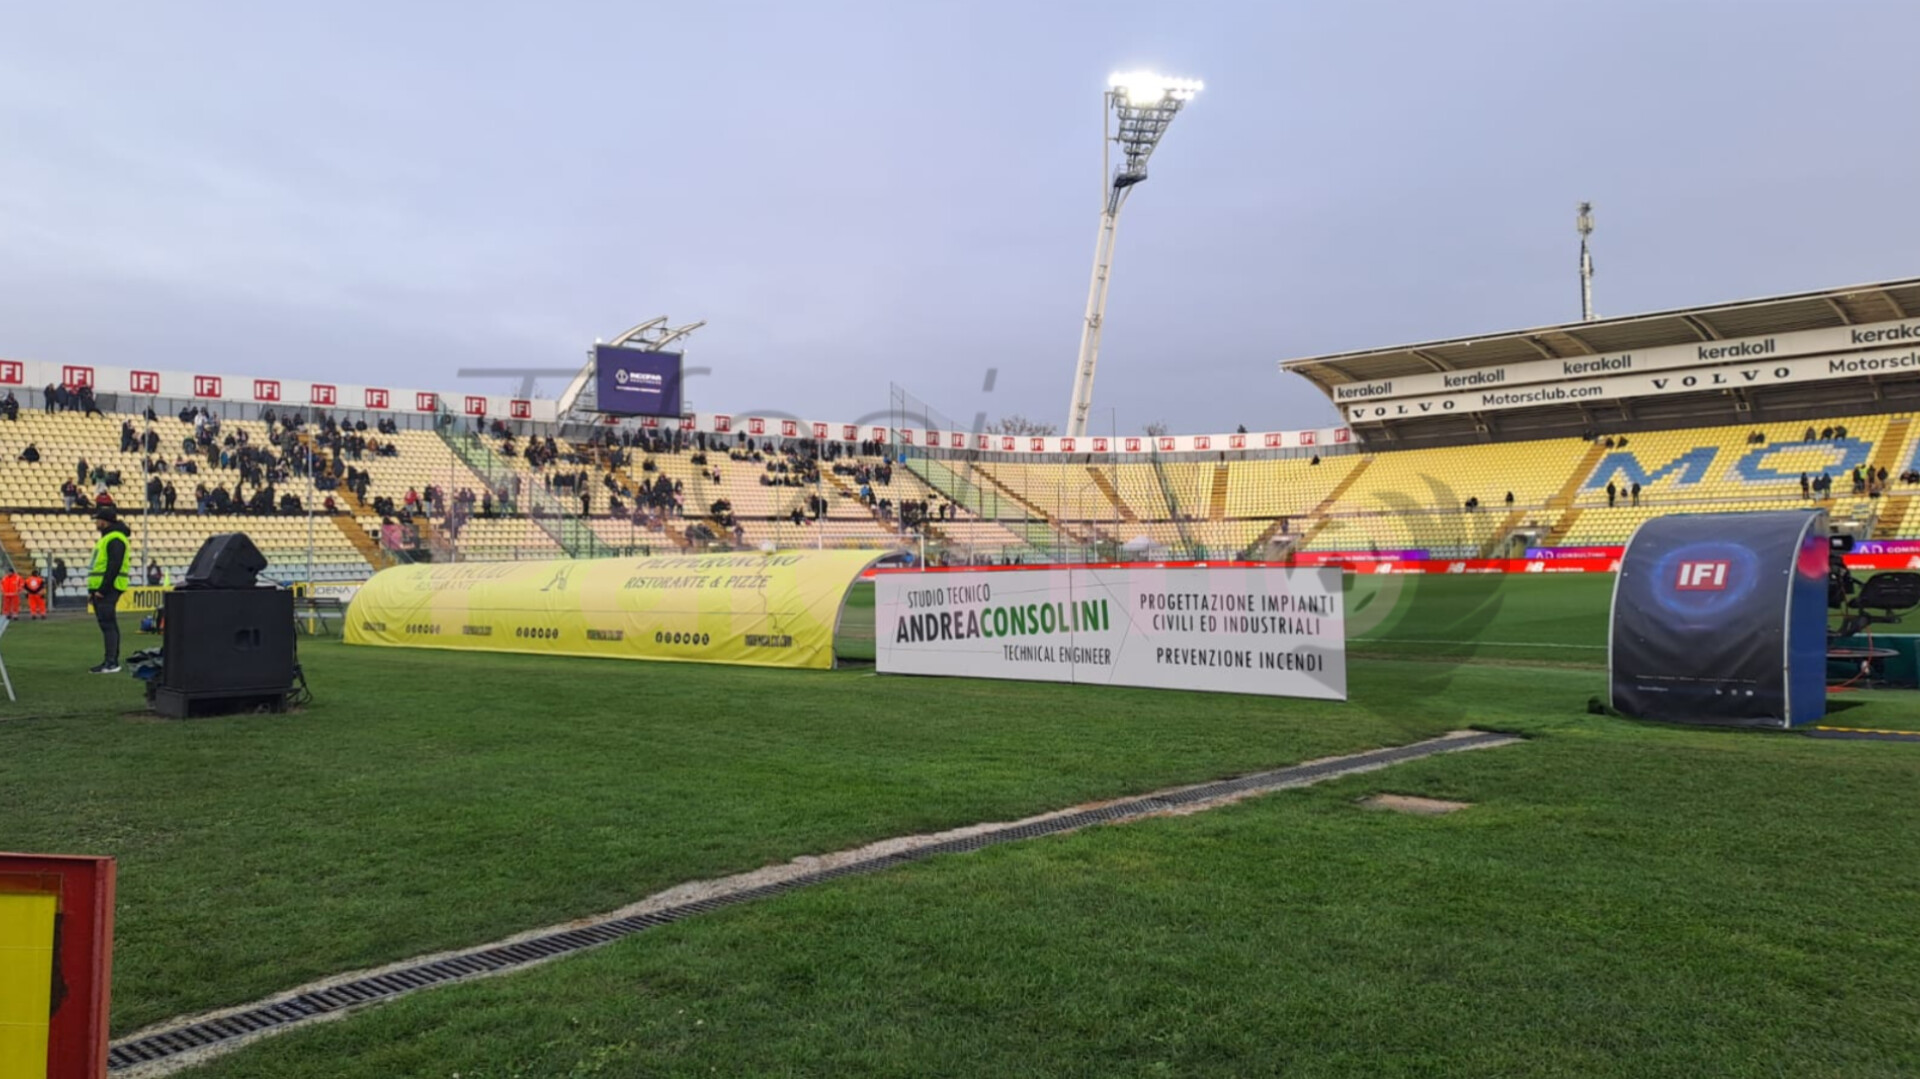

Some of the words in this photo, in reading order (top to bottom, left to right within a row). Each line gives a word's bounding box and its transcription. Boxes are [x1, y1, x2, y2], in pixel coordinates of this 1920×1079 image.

[1851, 324, 1920, 344] kerako
[1698, 339, 1775, 360] kerakoll
[1563, 355, 1632, 375] kerakoll
[1829, 352, 1920, 374] Motorscl
[0, 364, 22, 382] FI
[65, 368, 92, 387] IFI
[132, 374, 157, 391] IFI
[1444, 369, 1505, 388] kerakoll
[1652, 367, 1791, 390] VOLVO
[196, 378, 221, 395] IFI
[256, 382, 279, 399] IFI
[313, 387, 335, 403] IFI
[1337, 382, 1392, 399] kerakoll
[1482, 385, 1603, 407] Motorsclub.com
[367, 391, 388, 407] IFI
[418, 394, 437, 410] IFI
[467, 398, 486, 414] IFI
[512, 402, 530, 417] IFI
[1353, 400, 1455, 418] VOLVO
[624, 576, 705, 590] RISTORANTE
[710, 577, 721, 589] &
[724, 575, 771, 589] PIZZE
[1679, 563, 1727, 587] IFI
[133, 590, 163, 608] MOD
[908, 588, 944, 609] STUDIO
[947, 583, 991, 604] TECNICO
[1140, 593, 1255, 612] PROGETTAZIONE
[1261, 595, 1335, 614] IMPIANTI
[896, 598, 1110, 643] ANDREACONSOLINI
[1153, 614, 1195, 632] CIVILI
[1200, 615, 1218, 632] ED
[1223, 617, 1321, 636] INDUSTRIALI
[1003, 644, 1056, 663] TECHNICAL
[1059, 646, 1111, 665] ENGINEER
[1156, 647, 1253, 669] PREVENZIONE
[1259, 651, 1324, 672] INCENDI
